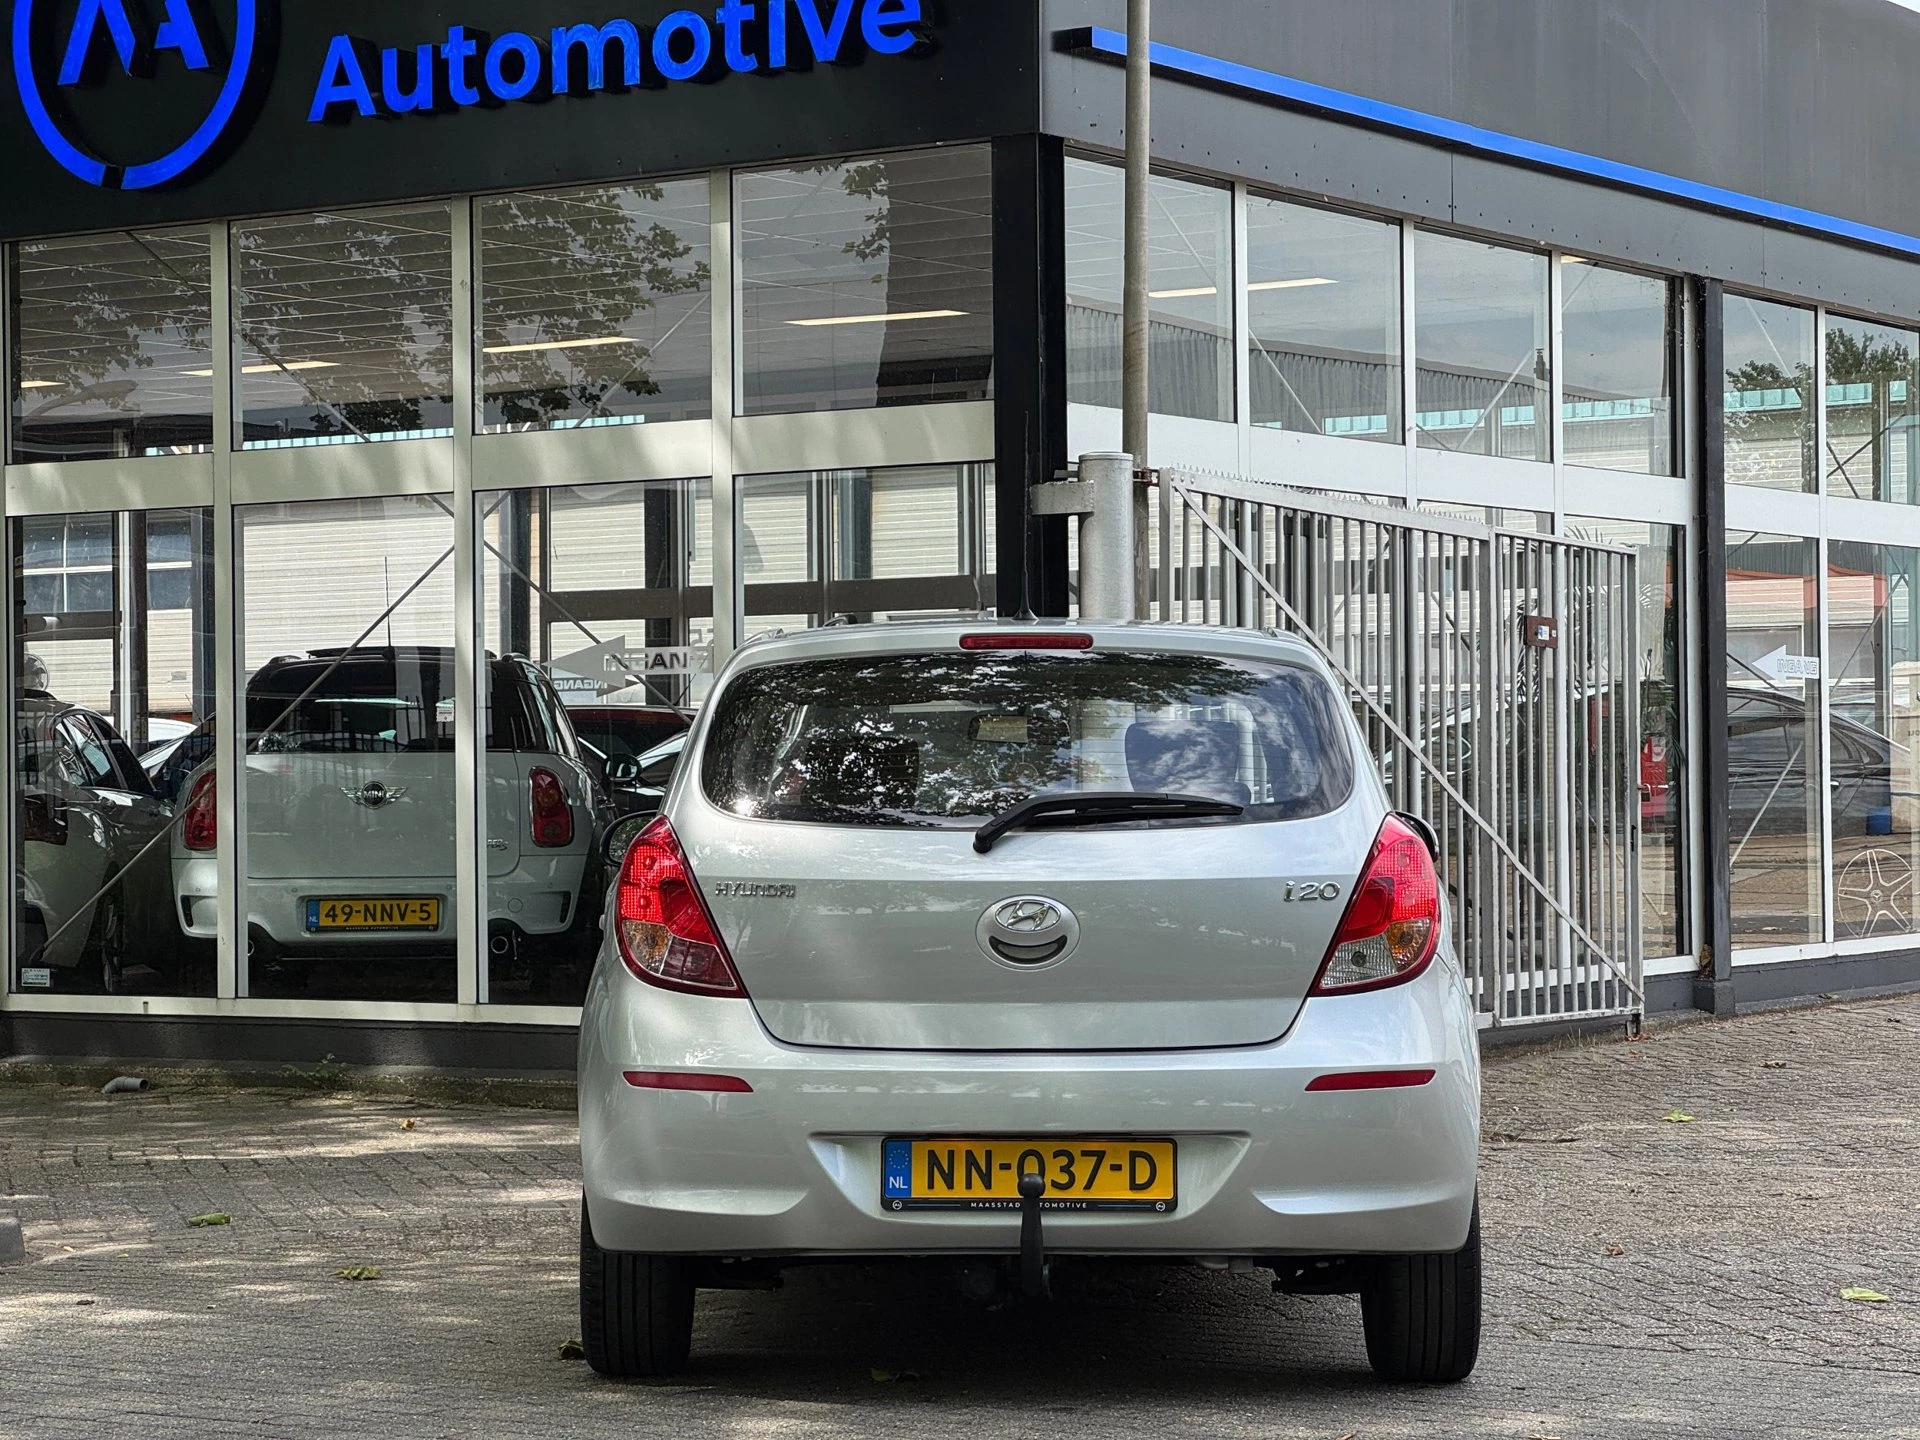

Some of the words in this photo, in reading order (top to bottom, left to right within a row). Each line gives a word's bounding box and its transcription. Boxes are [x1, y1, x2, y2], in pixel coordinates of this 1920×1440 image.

[307, 0, 921, 122] Automotive
[364, 791, 385, 799] MINI
[715, 881, 796, 897] HYUNDAI
[1284, 880, 1341, 902] i20
[324, 903, 431, 922] 49-NNV-5
[926, 1149, 1157, 1191] NN-037-D
[889, 1176, 908, 1189] NL
